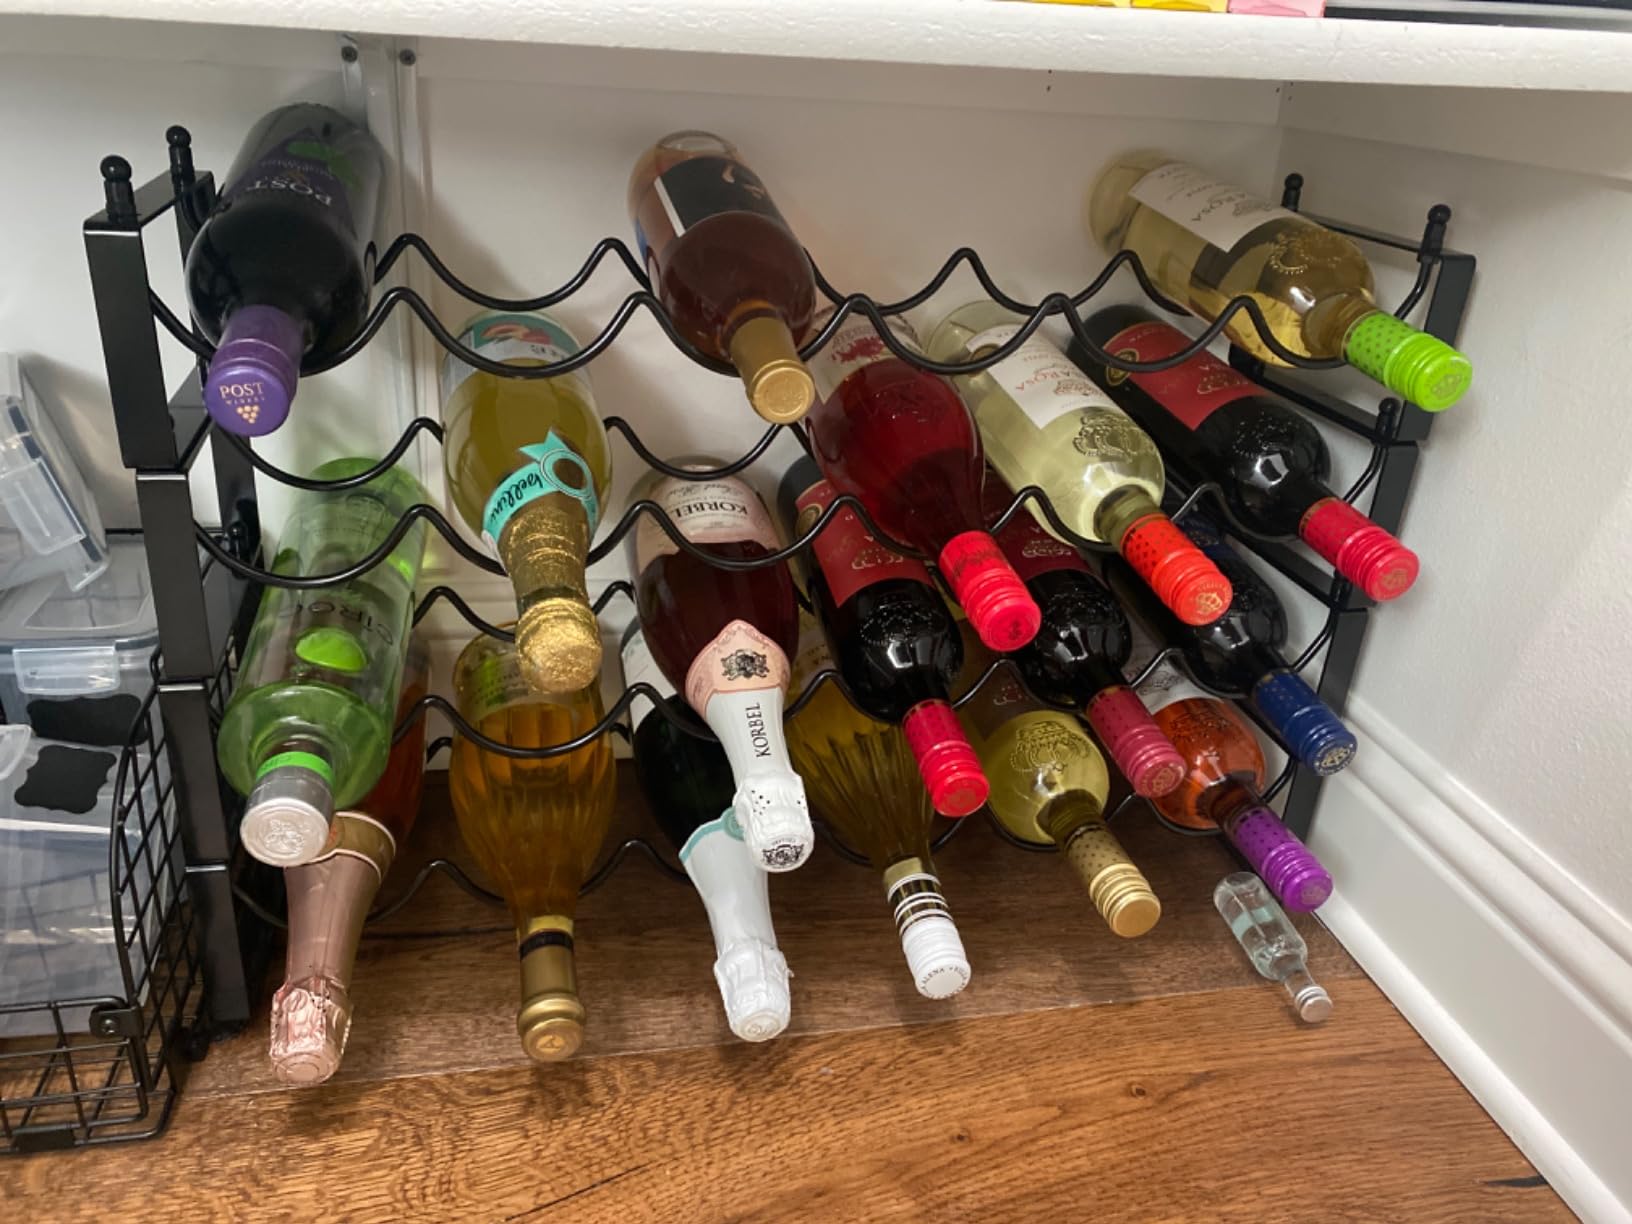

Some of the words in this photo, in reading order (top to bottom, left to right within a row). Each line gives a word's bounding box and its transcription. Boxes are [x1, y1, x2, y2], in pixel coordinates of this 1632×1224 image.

[246, 180, 332, 207] POST
[219, 382, 264, 399] POST
[669, 501, 748, 519] KORBEL
[745, 702, 771, 758] KORBEL
